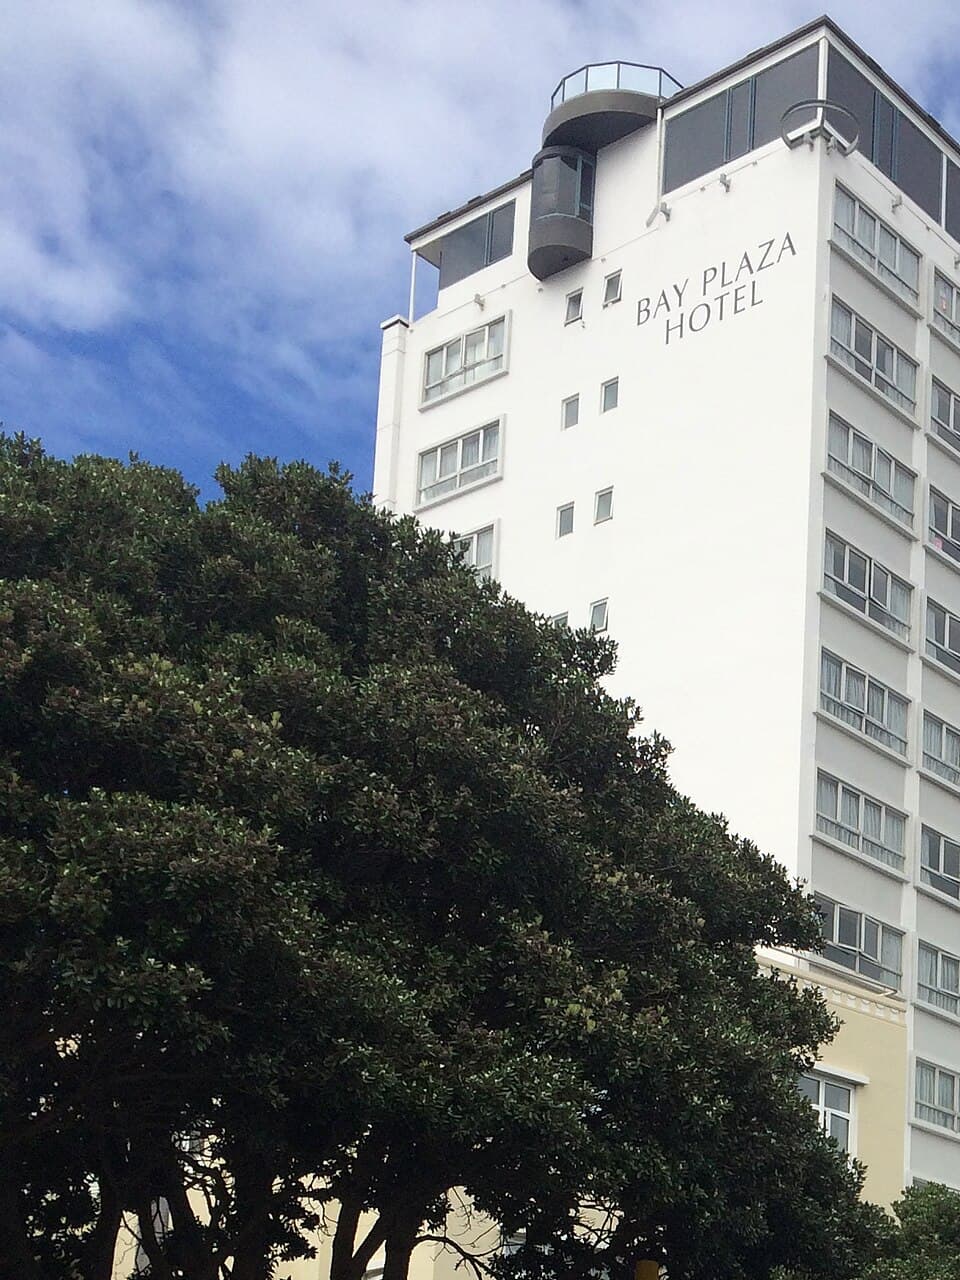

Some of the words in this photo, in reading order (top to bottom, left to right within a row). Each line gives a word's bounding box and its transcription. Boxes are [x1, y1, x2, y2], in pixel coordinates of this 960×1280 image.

[636, 278, 689, 326] BAY
[702, 231, 797, 297] PLAZA
[665, 280, 763, 345] HOTEL
